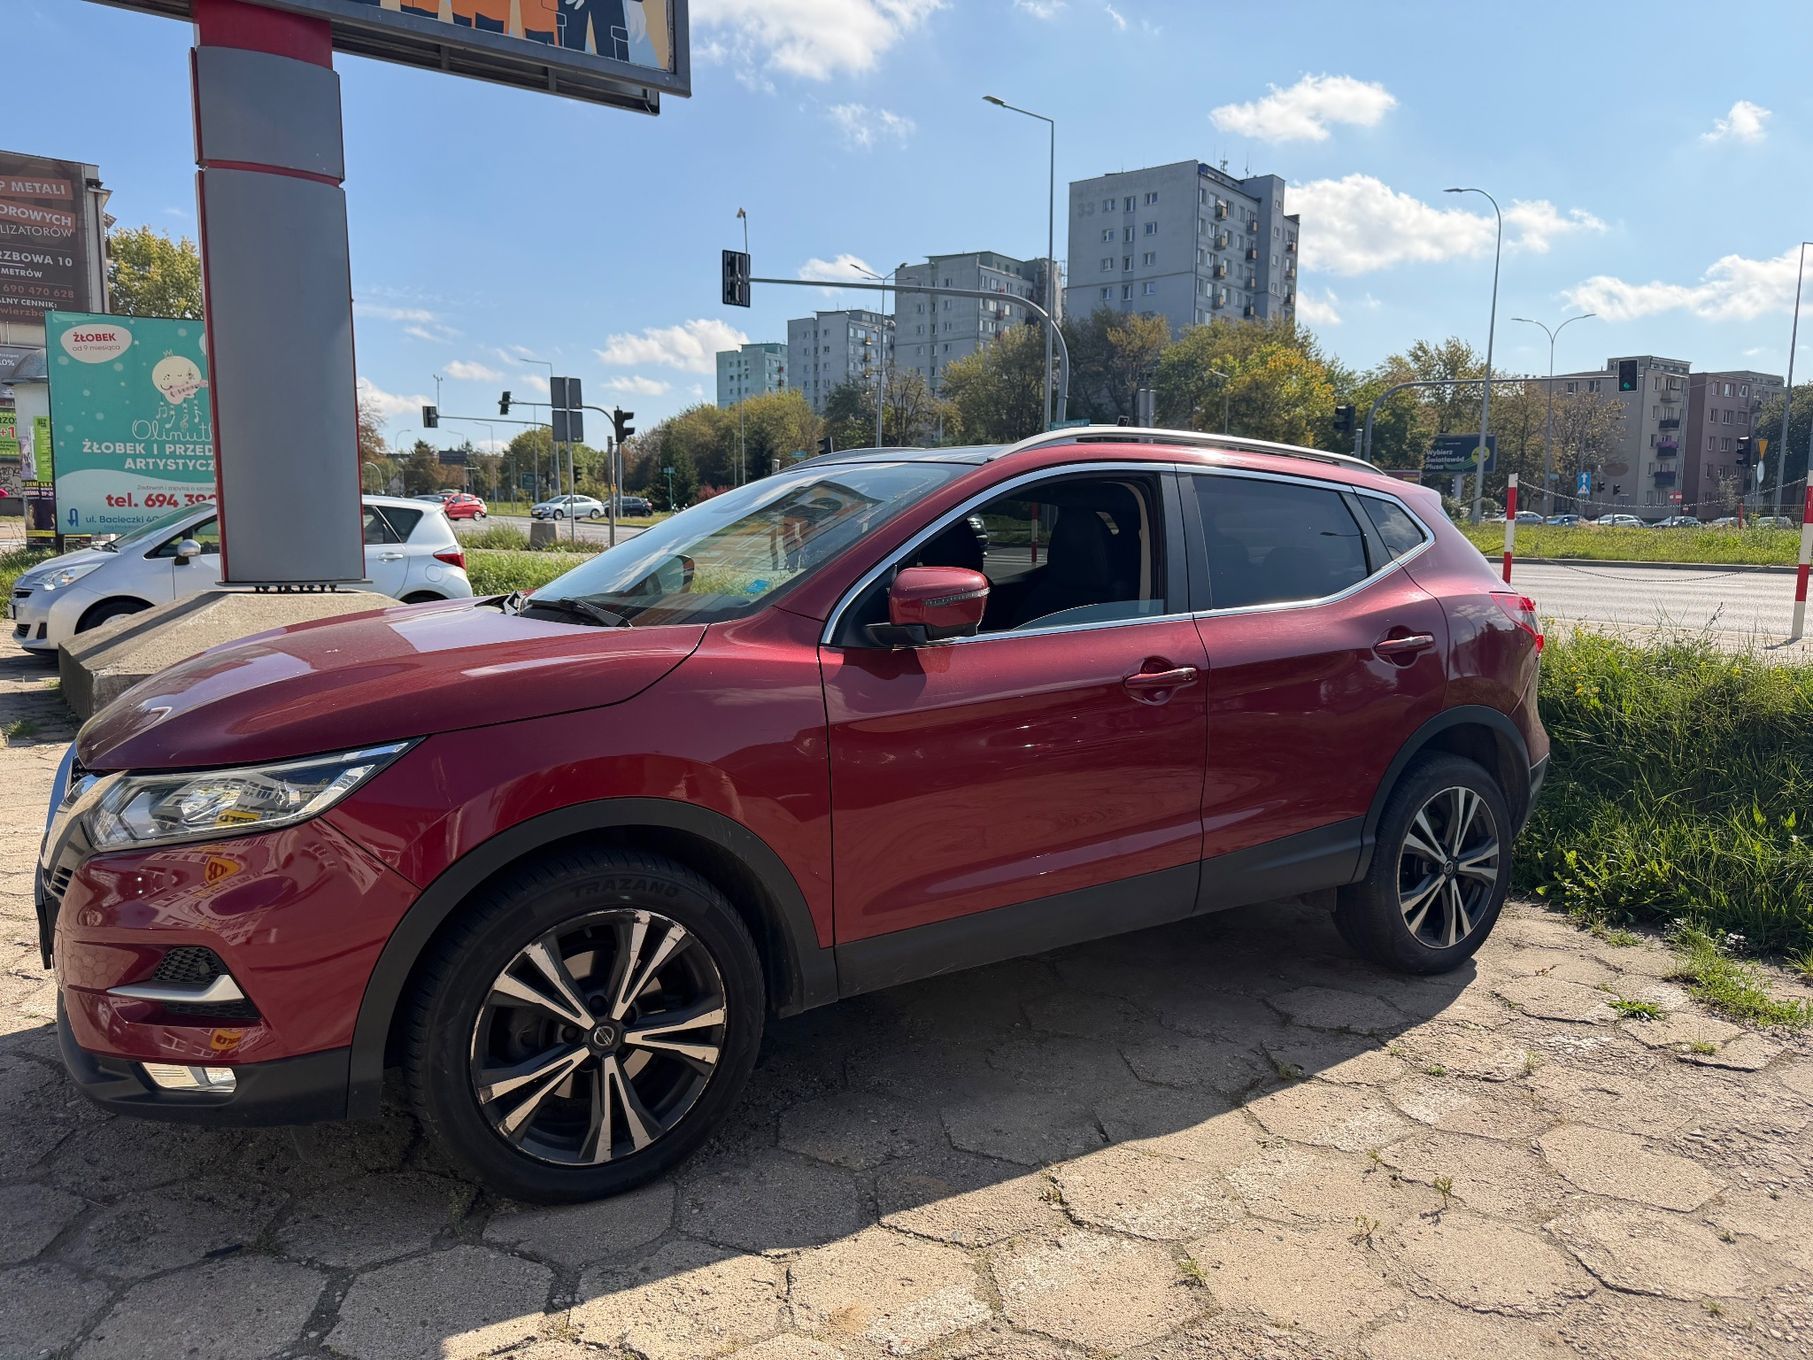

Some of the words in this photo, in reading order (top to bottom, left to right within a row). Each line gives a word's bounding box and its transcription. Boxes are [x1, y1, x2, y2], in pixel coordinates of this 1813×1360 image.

[11, 181, 66, 195] METALI
[0, 250, 53, 265] ZBOWA
[58, 256, 73, 267] 10
[0, 267, 43, 278] METRÓW
[3, 284, 25, 294] 690
[28, 286, 50, 296] 470
[53, 289, 74, 298] 628
[73, 331, 116, 342] ŻŁOBEK
[82, 438, 146, 454] ŻŁOBEK
[153, 443, 158, 455] I
[1425, 449, 1453, 457] Wybierz
[124, 458, 216, 471] ARTYSTYCZ
[105, 492, 139, 507] tel.
[144, 493, 179, 508] 694
[85, 515, 97, 524] ul.
[99, 515, 144, 524] Bacieczki
[570, 878, 680, 898] TRAZANO
